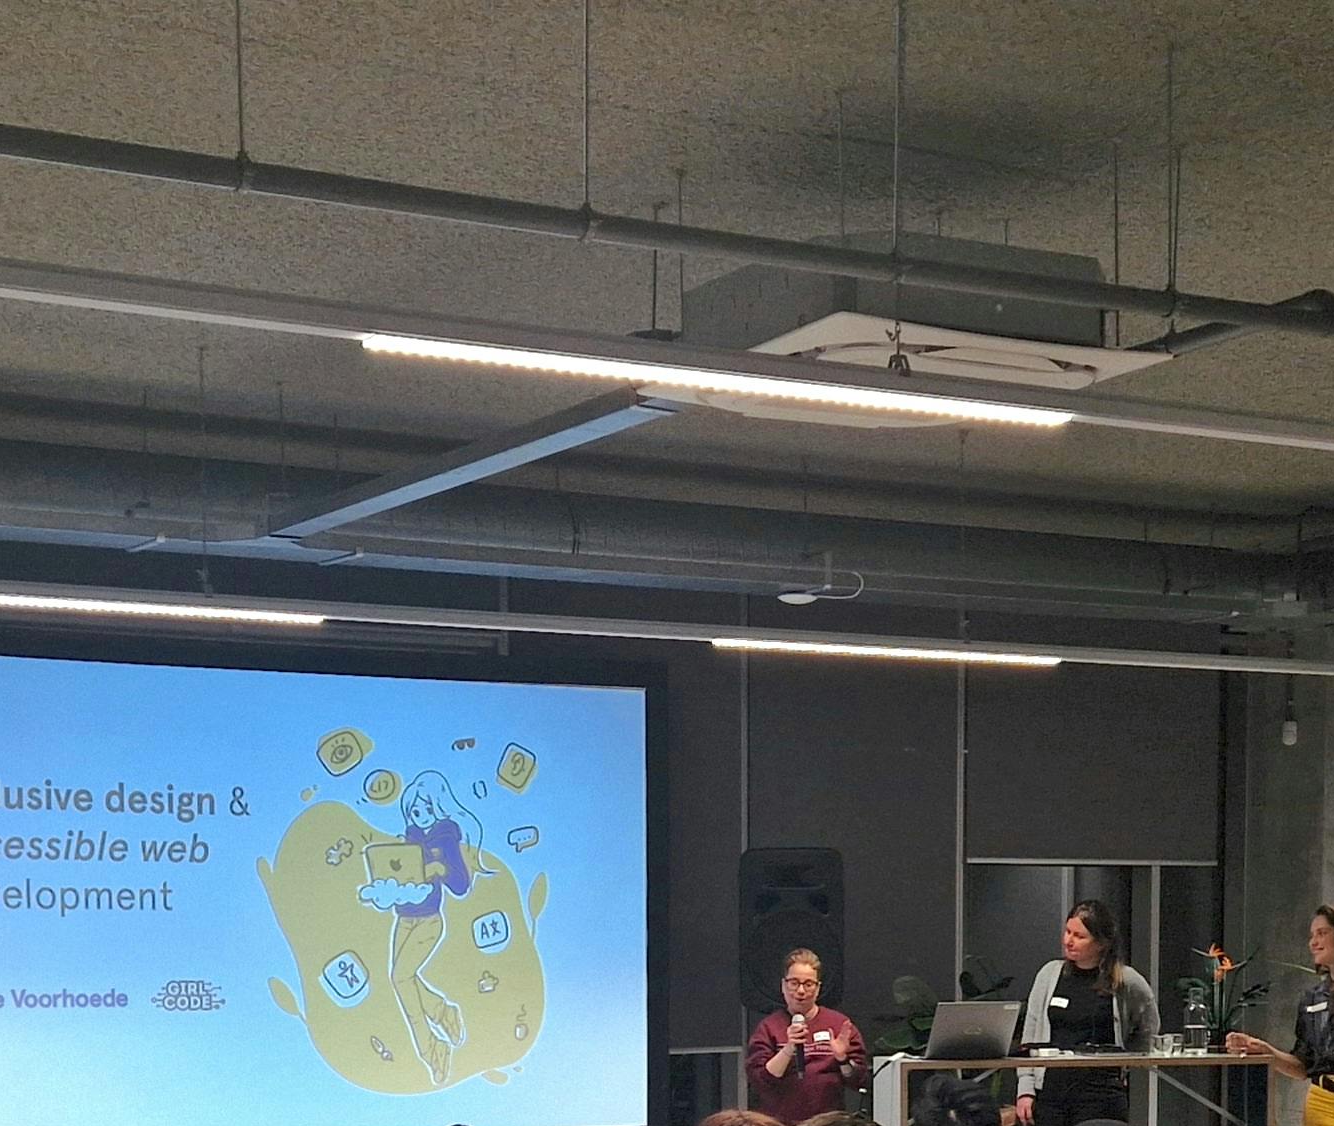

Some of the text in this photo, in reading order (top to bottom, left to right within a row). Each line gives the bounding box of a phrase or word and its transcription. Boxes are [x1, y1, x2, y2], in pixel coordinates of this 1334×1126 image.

[104, 782, 216, 823] design
[229, 786, 250, 817] &
[140, 833, 210, 864] web
[12, 988, 128, 1009] Voorhoede
[167, 982, 208, 996] GIRL
[163, 996, 211, 1009] CODE
